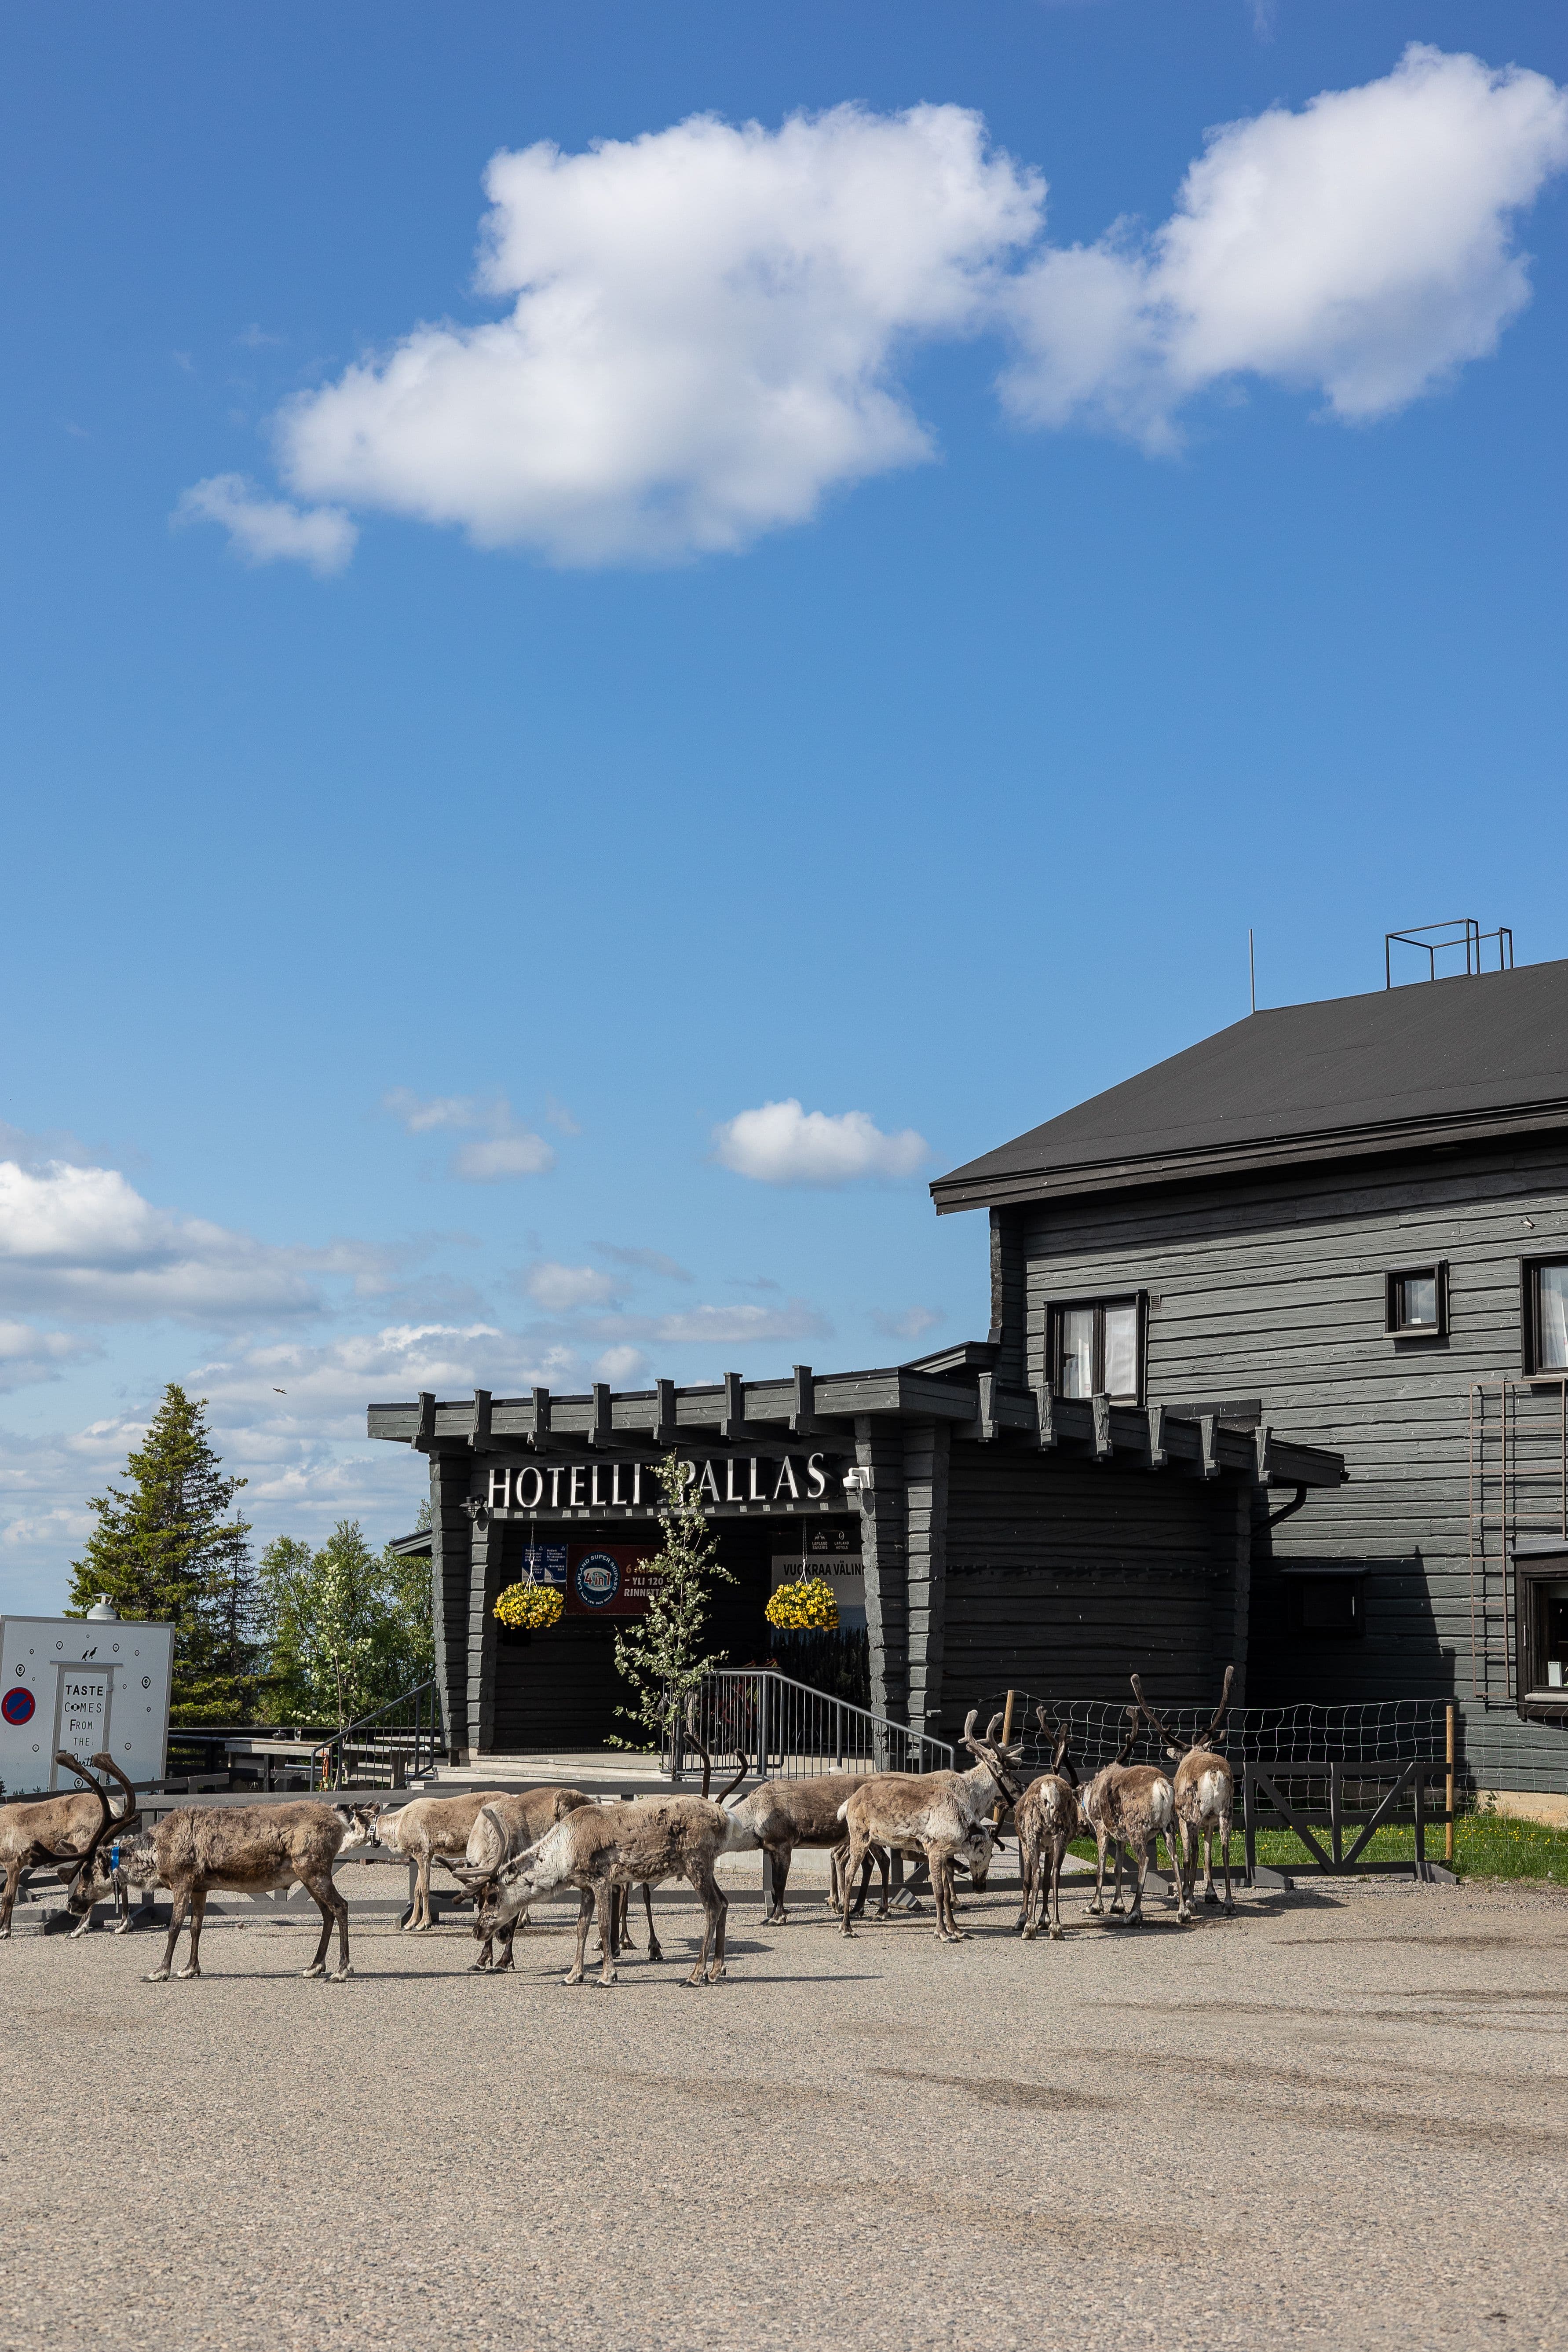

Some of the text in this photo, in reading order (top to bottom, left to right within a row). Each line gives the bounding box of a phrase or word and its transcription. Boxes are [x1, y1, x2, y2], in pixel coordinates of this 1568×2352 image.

[488, 1453, 825, 1508] HOTELLI PALLAS
[577, 1559, 590, 1590] LAPLAND
[591, 1555, 610, 1563] SUPER
[626, 1564, 632, 1573] 6
[783, 1563, 832, 1576] VUOKRAA
[66, 1685, 104, 1696] TASTE
[64, 1702, 102, 1713] COMES
[73, 1737, 90, 1746] THE
